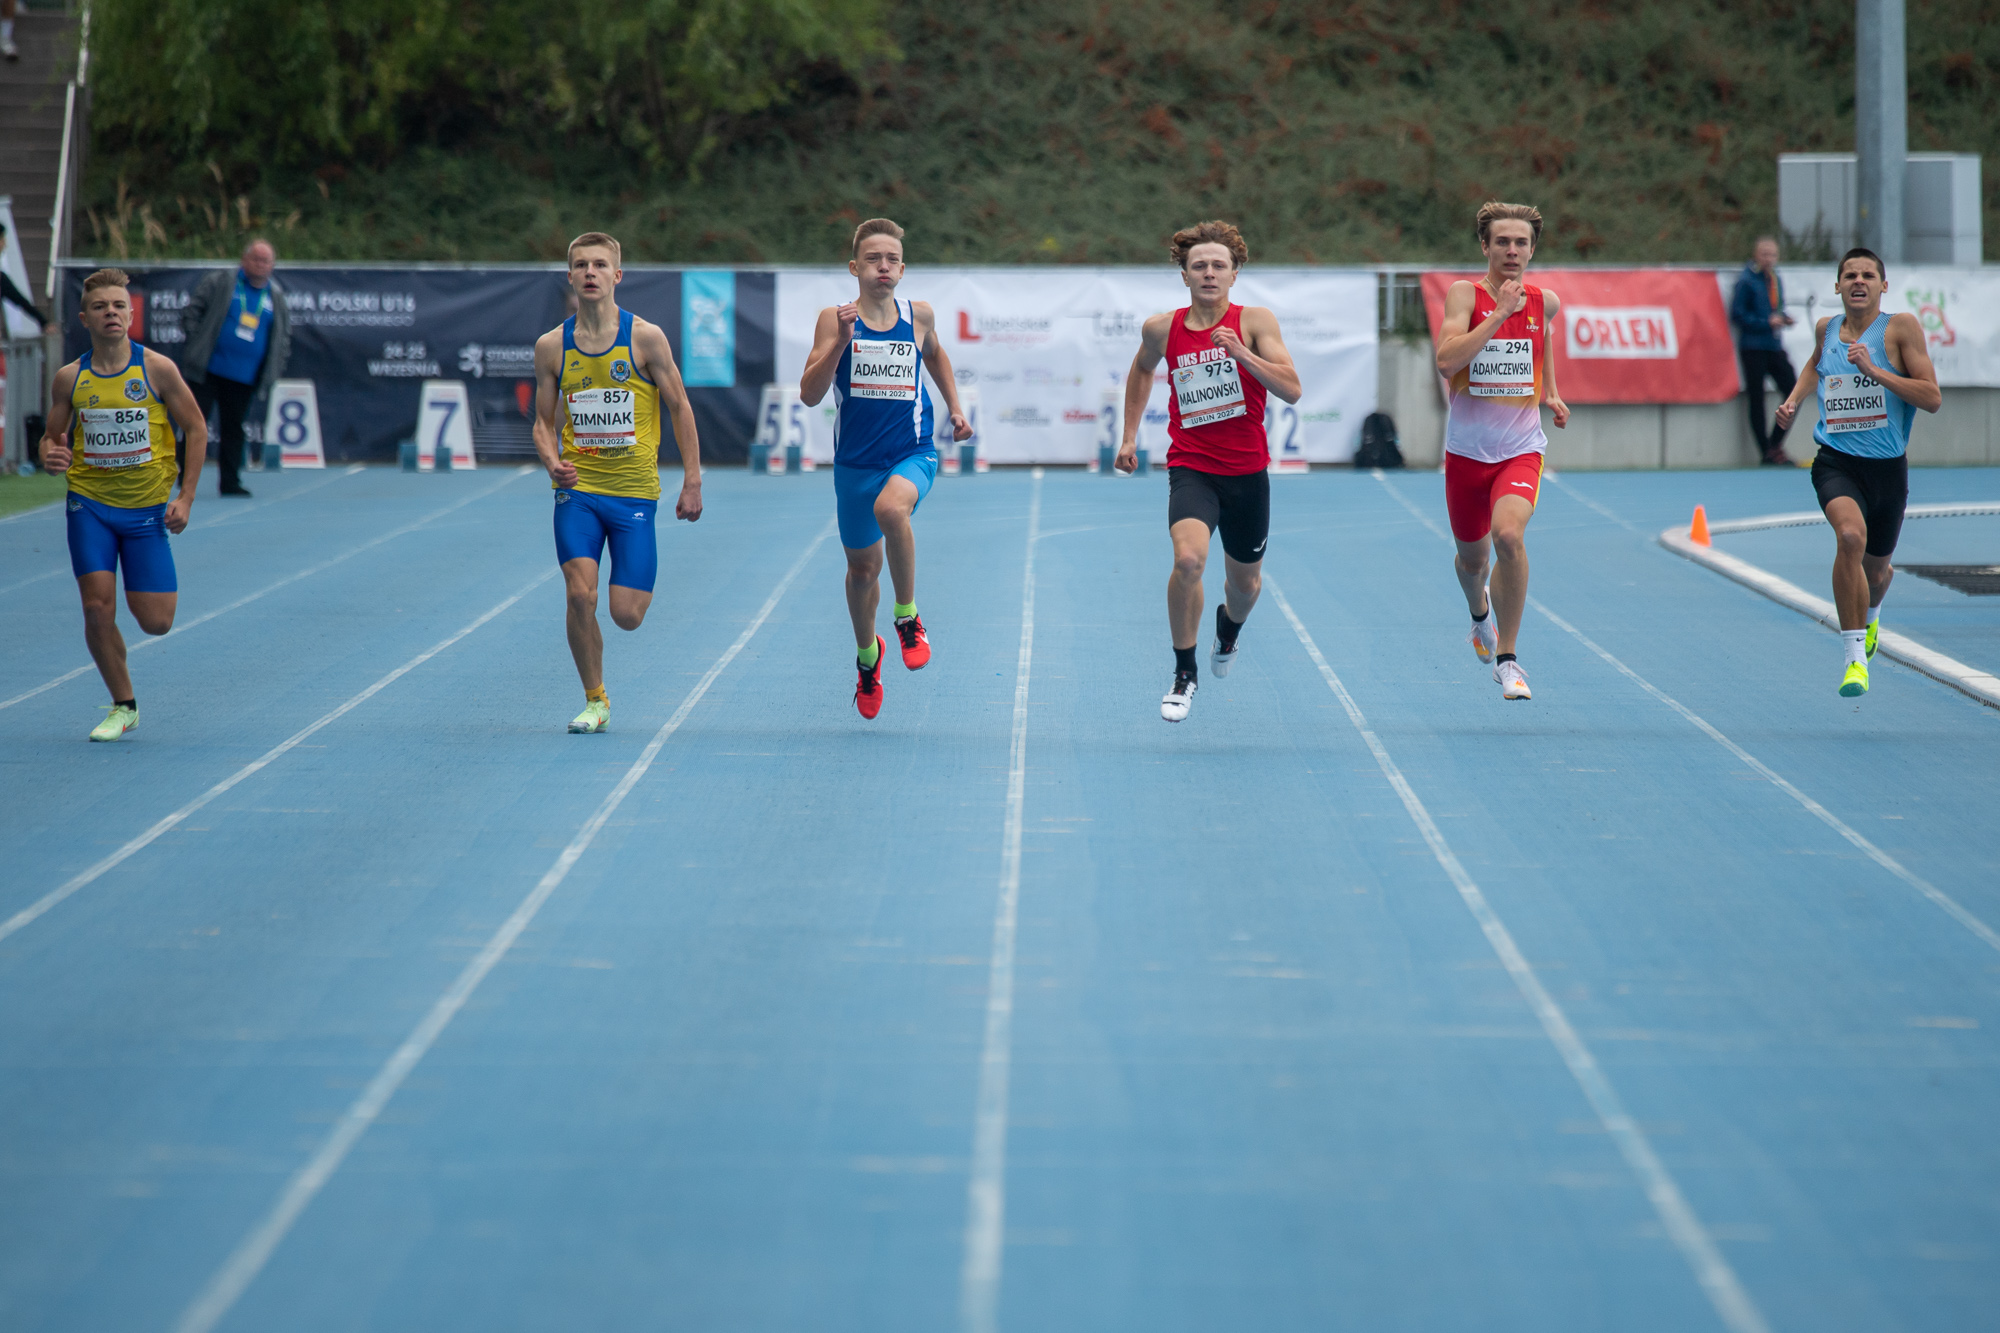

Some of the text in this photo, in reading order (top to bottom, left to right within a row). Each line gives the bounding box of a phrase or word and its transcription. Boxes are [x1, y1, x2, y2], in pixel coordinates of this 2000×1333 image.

[318, 292, 380, 312] POLSKI
[1576, 318, 1667, 350] ORLEN
[889, 343, 913, 356] 787
[1505, 341, 1530, 354] 294
[1177, 347, 1226, 368] UKS ATOS
[854, 363, 914, 378] ADAMCZYK
[1205, 360, 1233, 377] 973
[1472, 363, 1532, 375] ADAMCZEWSKI
[603, 391, 630, 403] 857
[862, 389, 887, 397] LUBLIN
[1179, 381, 1240, 407] MALINOWSKI
[1826, 395, 1883, 412] CIESZEWSKI
[114, 410, 145, 424] 856
[278, 401, 308, 447] 8
[428, 402, 460, 448] 7
[572, 411, 632, 426] ZIMNIAK
[1190, 414, 1215, 425] LUBLIN
[1216, 409, 1235, 419] 2022
[765, 403, 781, 450] 5
[790, 404, 806, 448] 5
[1100, 405, 1117, 447] 3
[1282, 406, 1299, 454] 2
[1833, 421, 1877, 431] LUBLIN 2022
[85, 428, 147, 446] WOJTASIK
[94, 456, 141, 466] LUBLIN 2022
